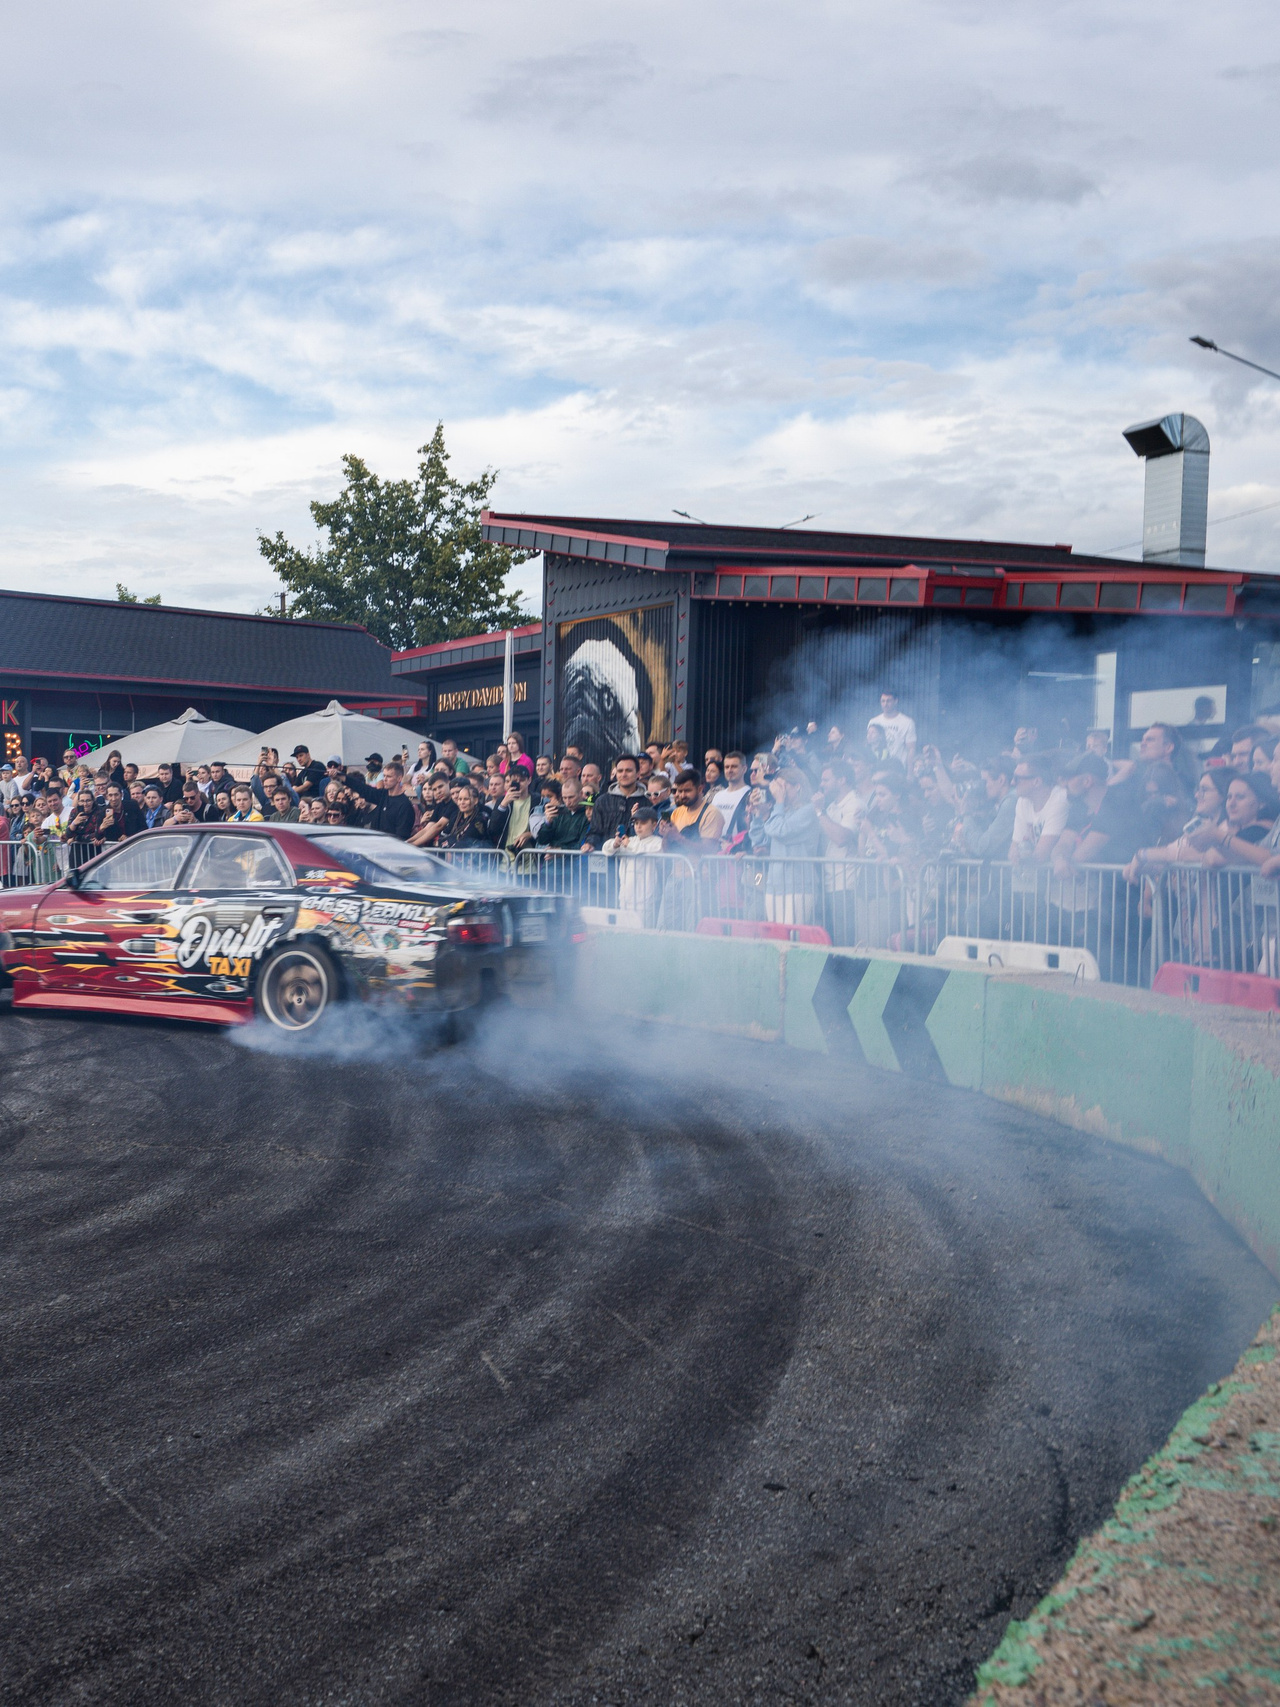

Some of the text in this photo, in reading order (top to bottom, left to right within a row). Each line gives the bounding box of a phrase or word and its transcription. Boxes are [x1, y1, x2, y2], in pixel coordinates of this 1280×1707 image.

[438, 681, 527, 712] HAPPY DAVIDON
[176, 914, 284, 969] Drift
[208, 956, 252, 977] TAXI
